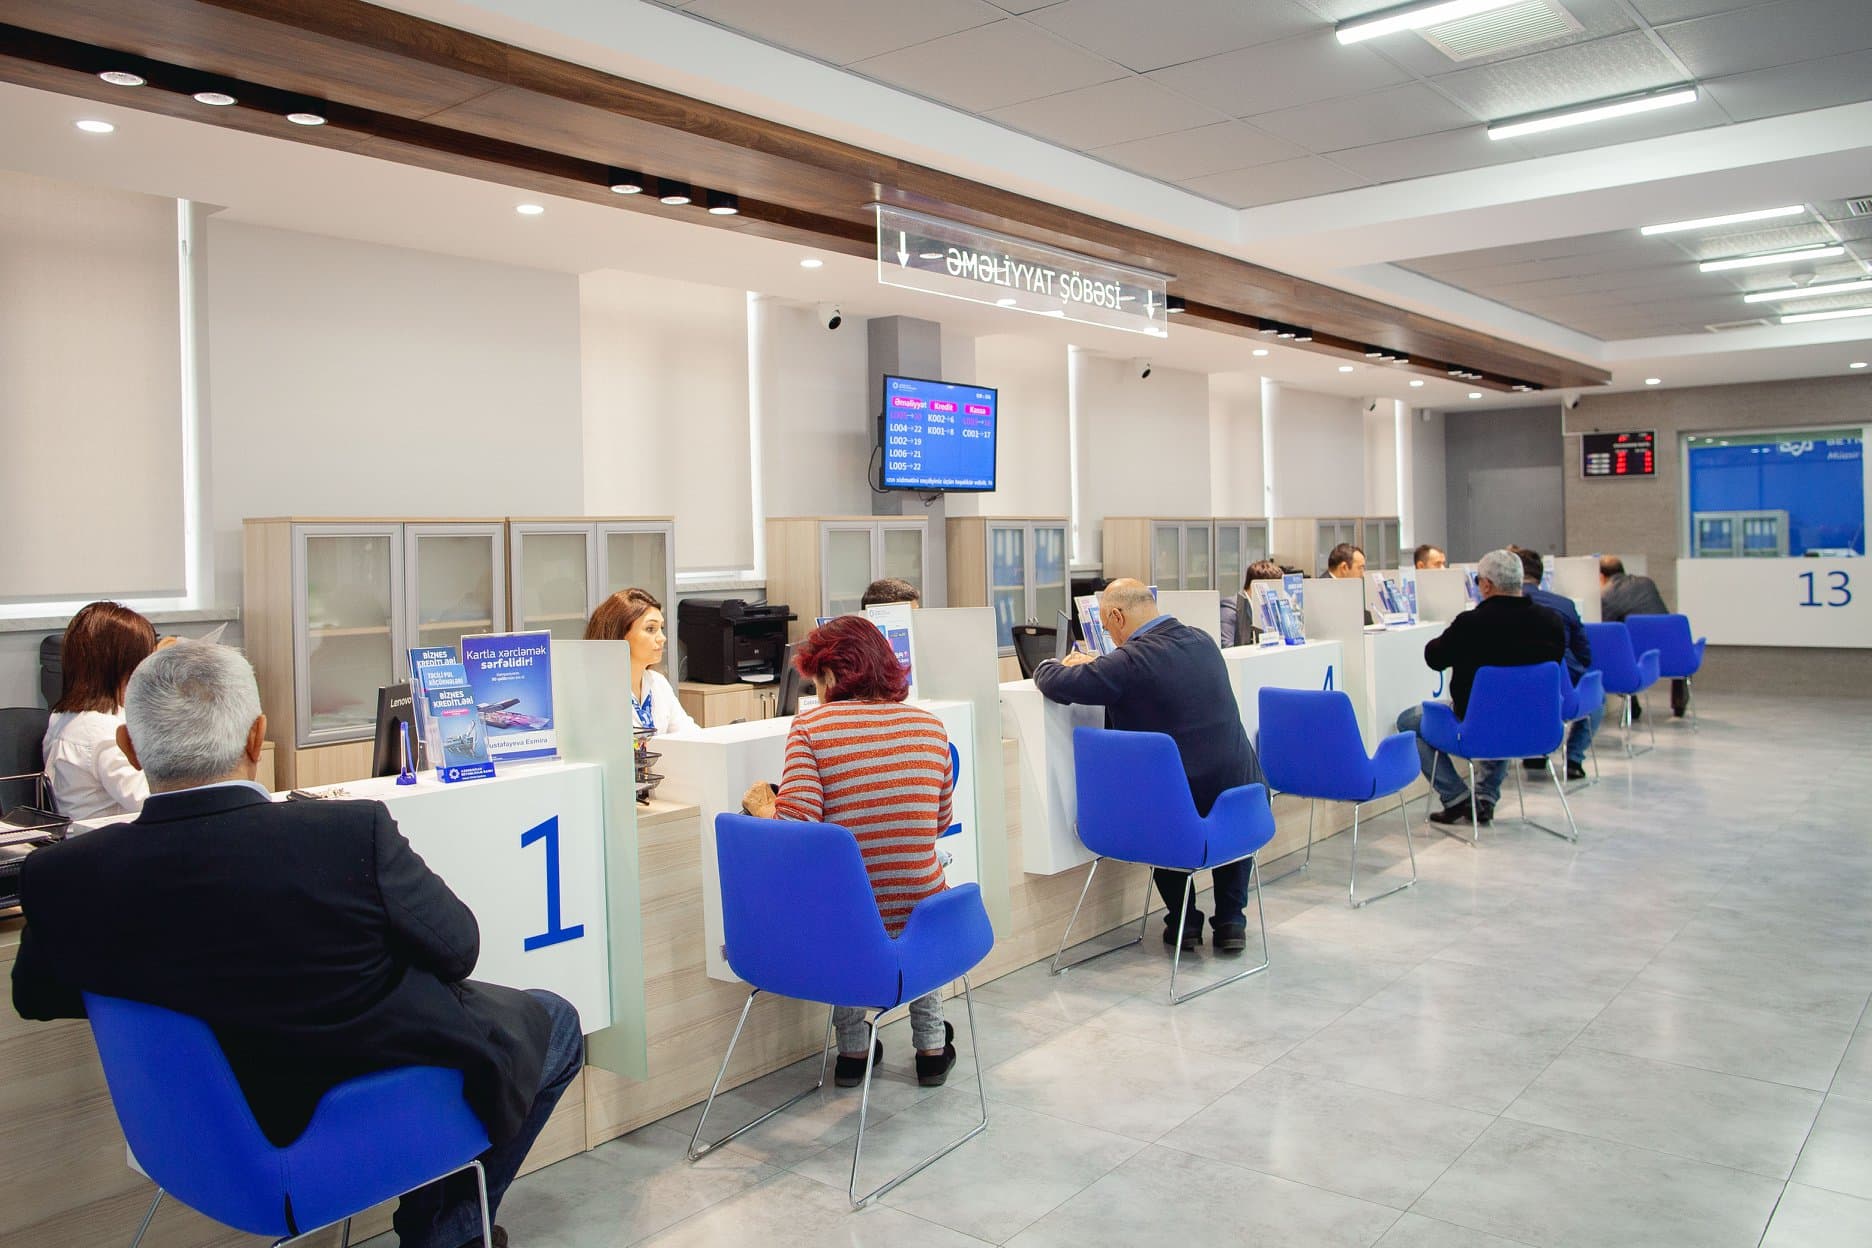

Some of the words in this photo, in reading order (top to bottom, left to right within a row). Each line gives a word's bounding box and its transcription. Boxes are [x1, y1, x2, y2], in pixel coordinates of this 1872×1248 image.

[946, 247, 1055, 296] ƏMƏLİYYAT
[1060, 271, 1122, 311] ŞÖBƏSİ
[1799, 571, 1853, 608] 13
[423, 651, 448, 659] BİZNES
[466, 649, 496, 660] Kartla
[498, 645, 547, 658] xərcləmək
[480, 656, 533, 670] sərfəlidir!
[439, 690, 464, 699] BİZNES
[390, 696, 412, 708] Lenovo
[433, 696, 474, 708] KREDİTLƏRİ
[489, 740, 525, 750] ustafayeva
[521, 814, 584, 952] 1
